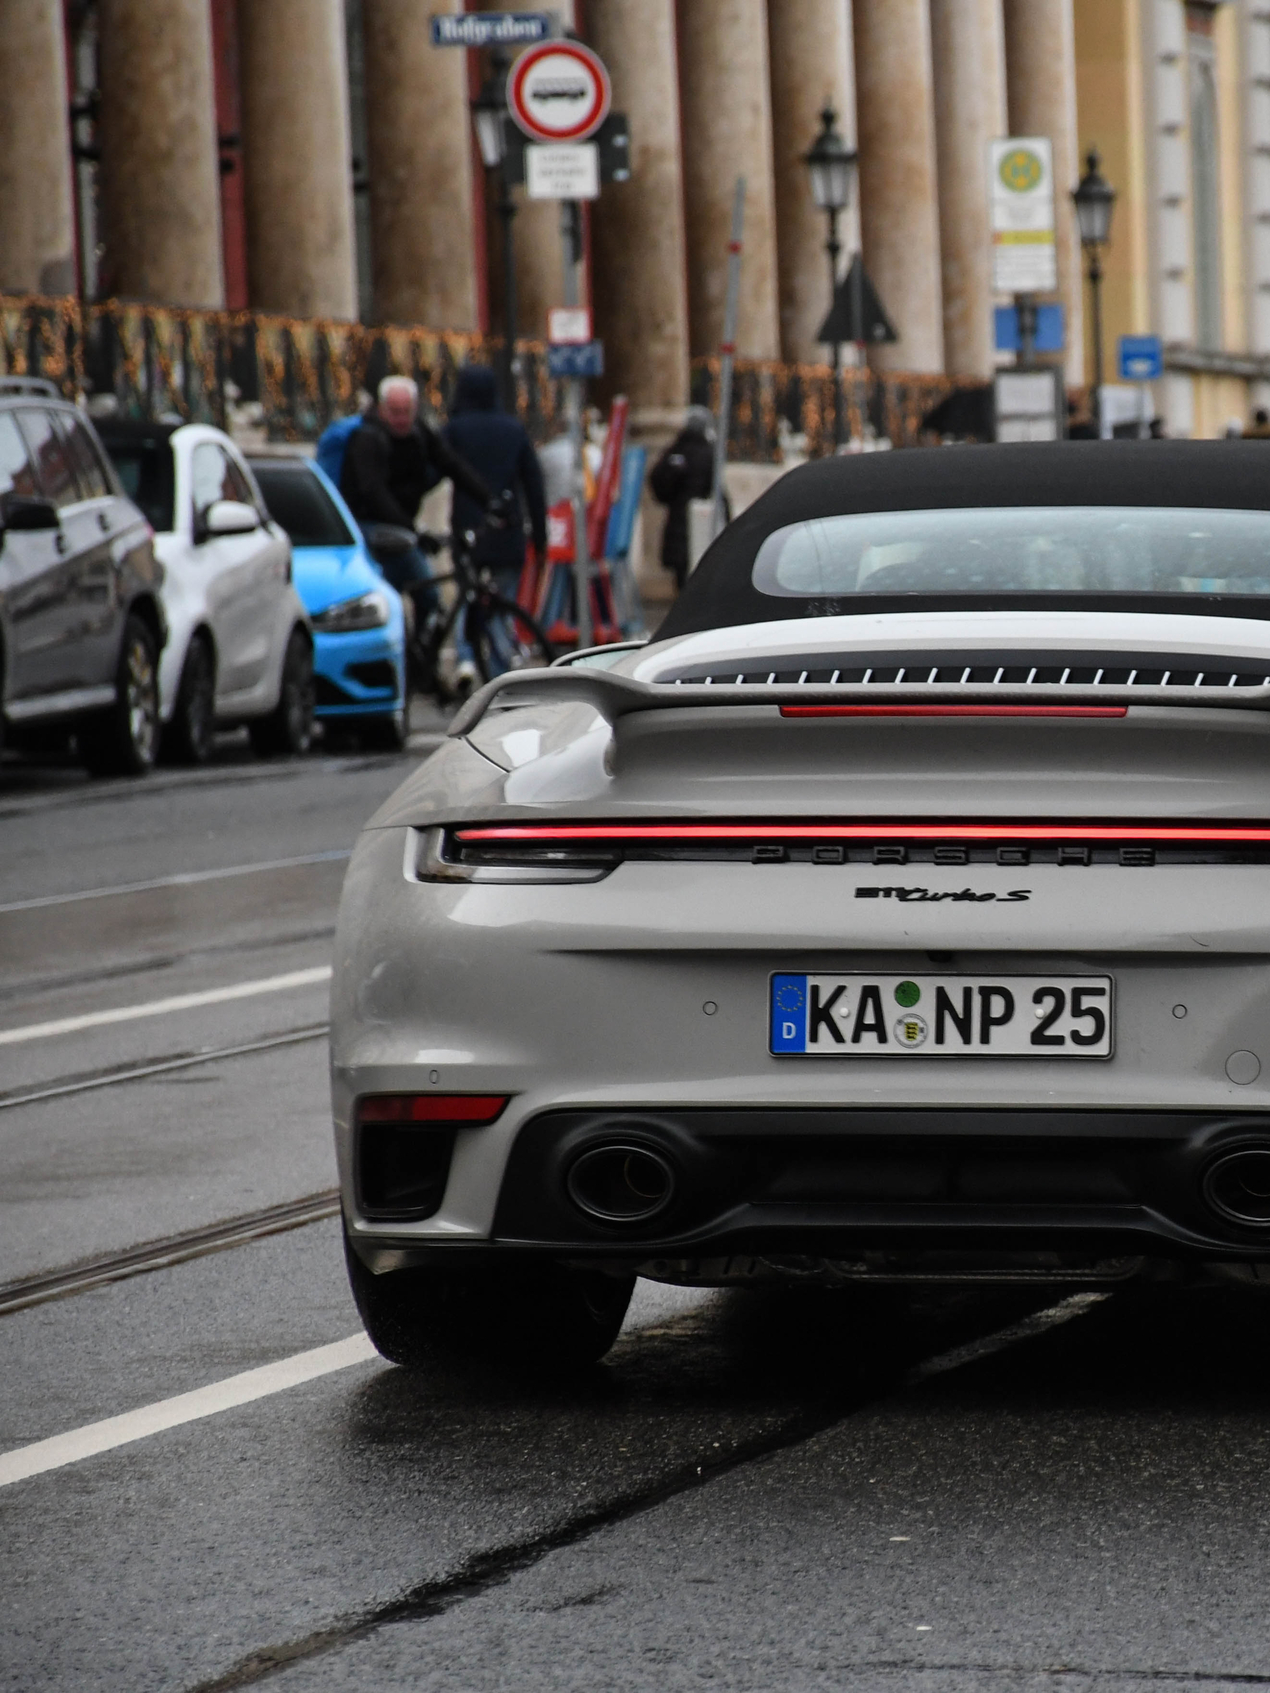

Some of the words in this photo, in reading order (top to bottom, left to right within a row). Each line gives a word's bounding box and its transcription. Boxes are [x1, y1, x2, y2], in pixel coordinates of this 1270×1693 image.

[752, 845, 1156, 866] PORSCHE
[995, 889, 1032, 902] S
[808, 984, 889, 1045] KA
[934, 985, 1015, 1046] NP
[1030, 986, 1107, 1047] 25
[781, 1021, 796, 1040] D
